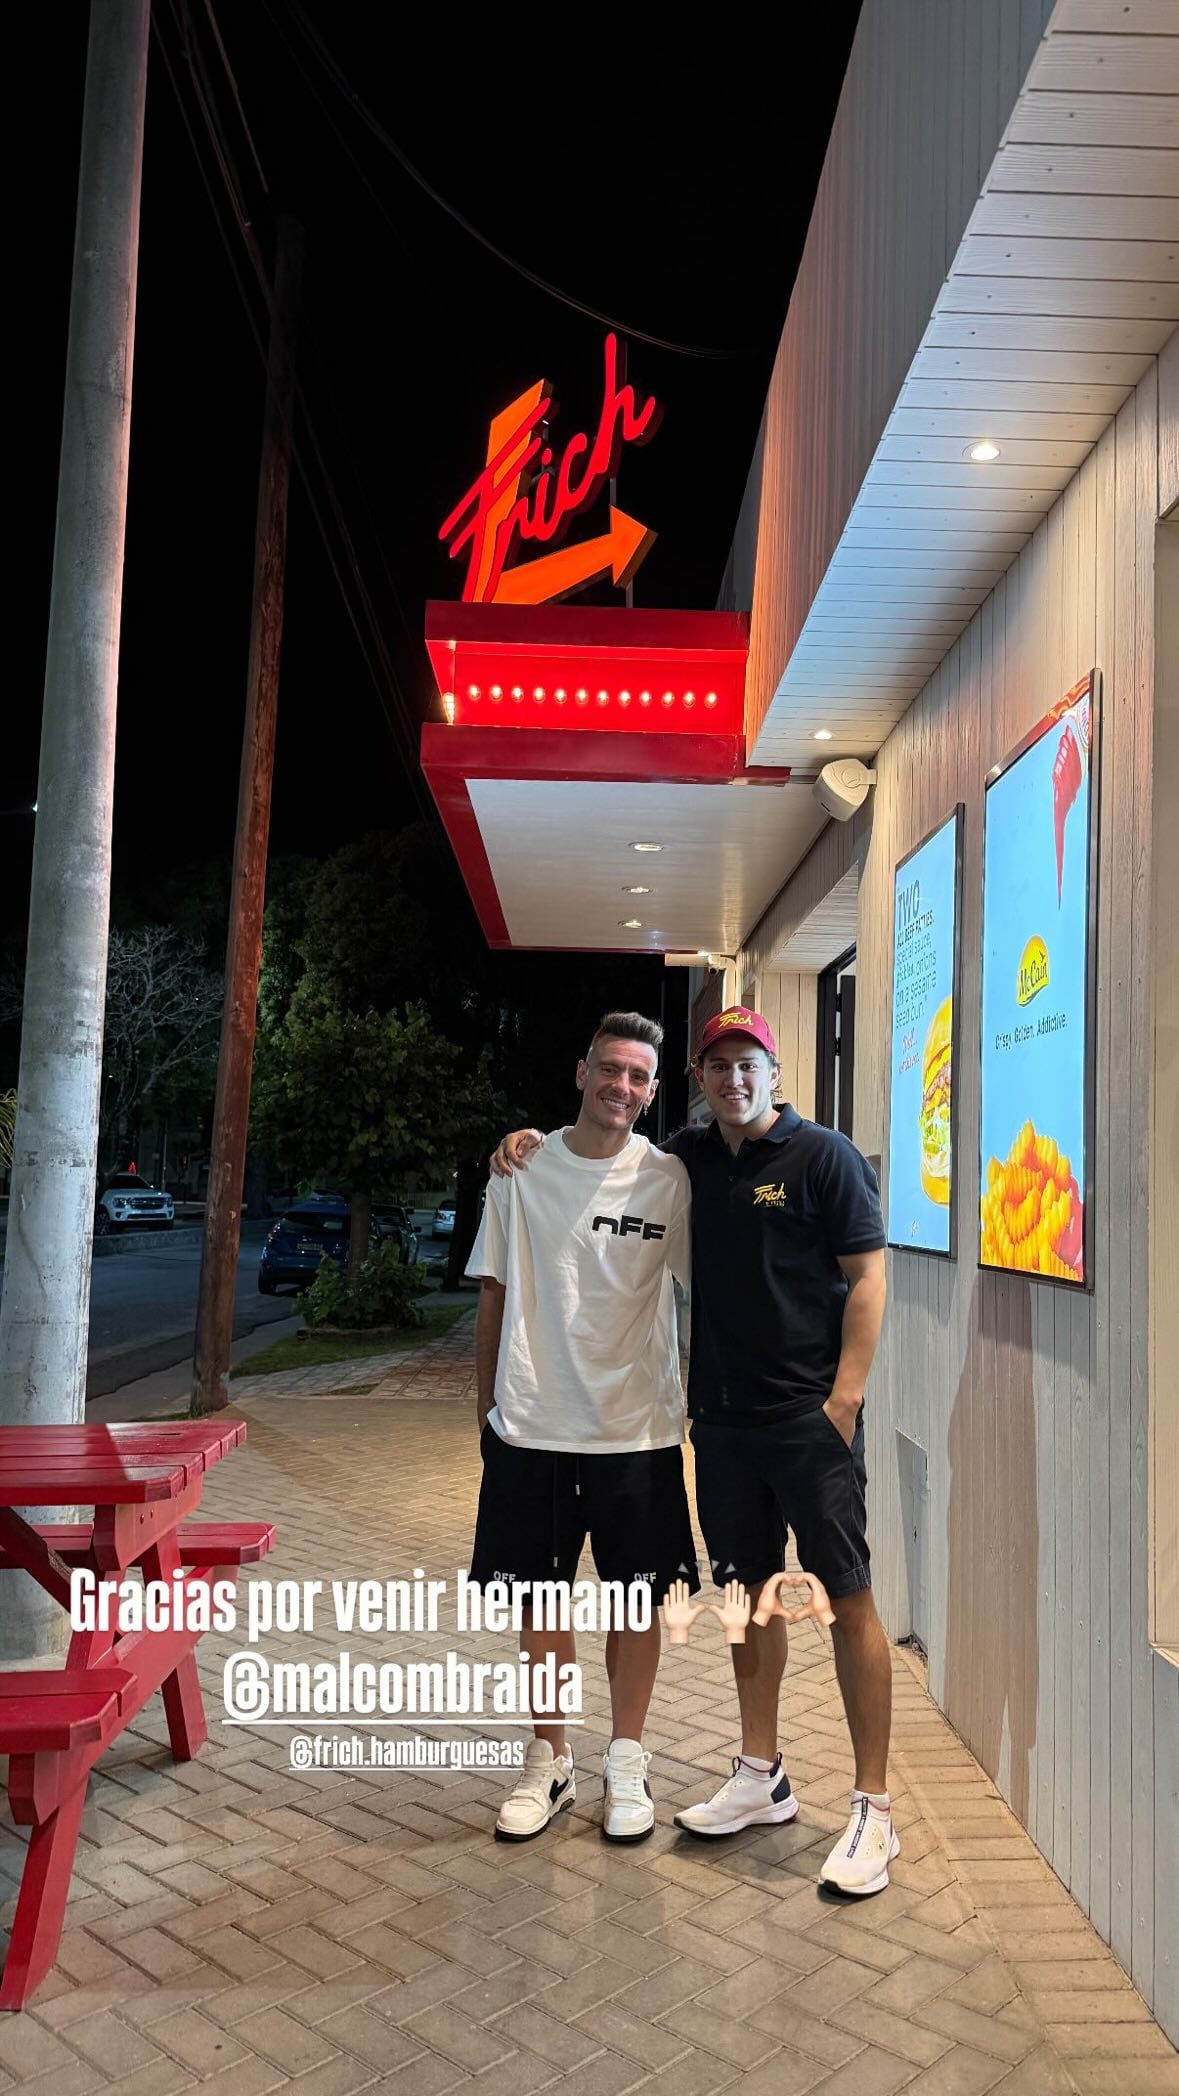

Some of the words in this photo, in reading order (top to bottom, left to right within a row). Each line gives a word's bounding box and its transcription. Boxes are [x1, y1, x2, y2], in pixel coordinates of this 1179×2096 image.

[438, 332, 656, 603] Frich
[897, 879, 920, 931] TWO
[1019, 959, 1048, 997] McCain
[718, 1012, 754, 1029] Frich
[753, 1182, 787, 1205] Frich
